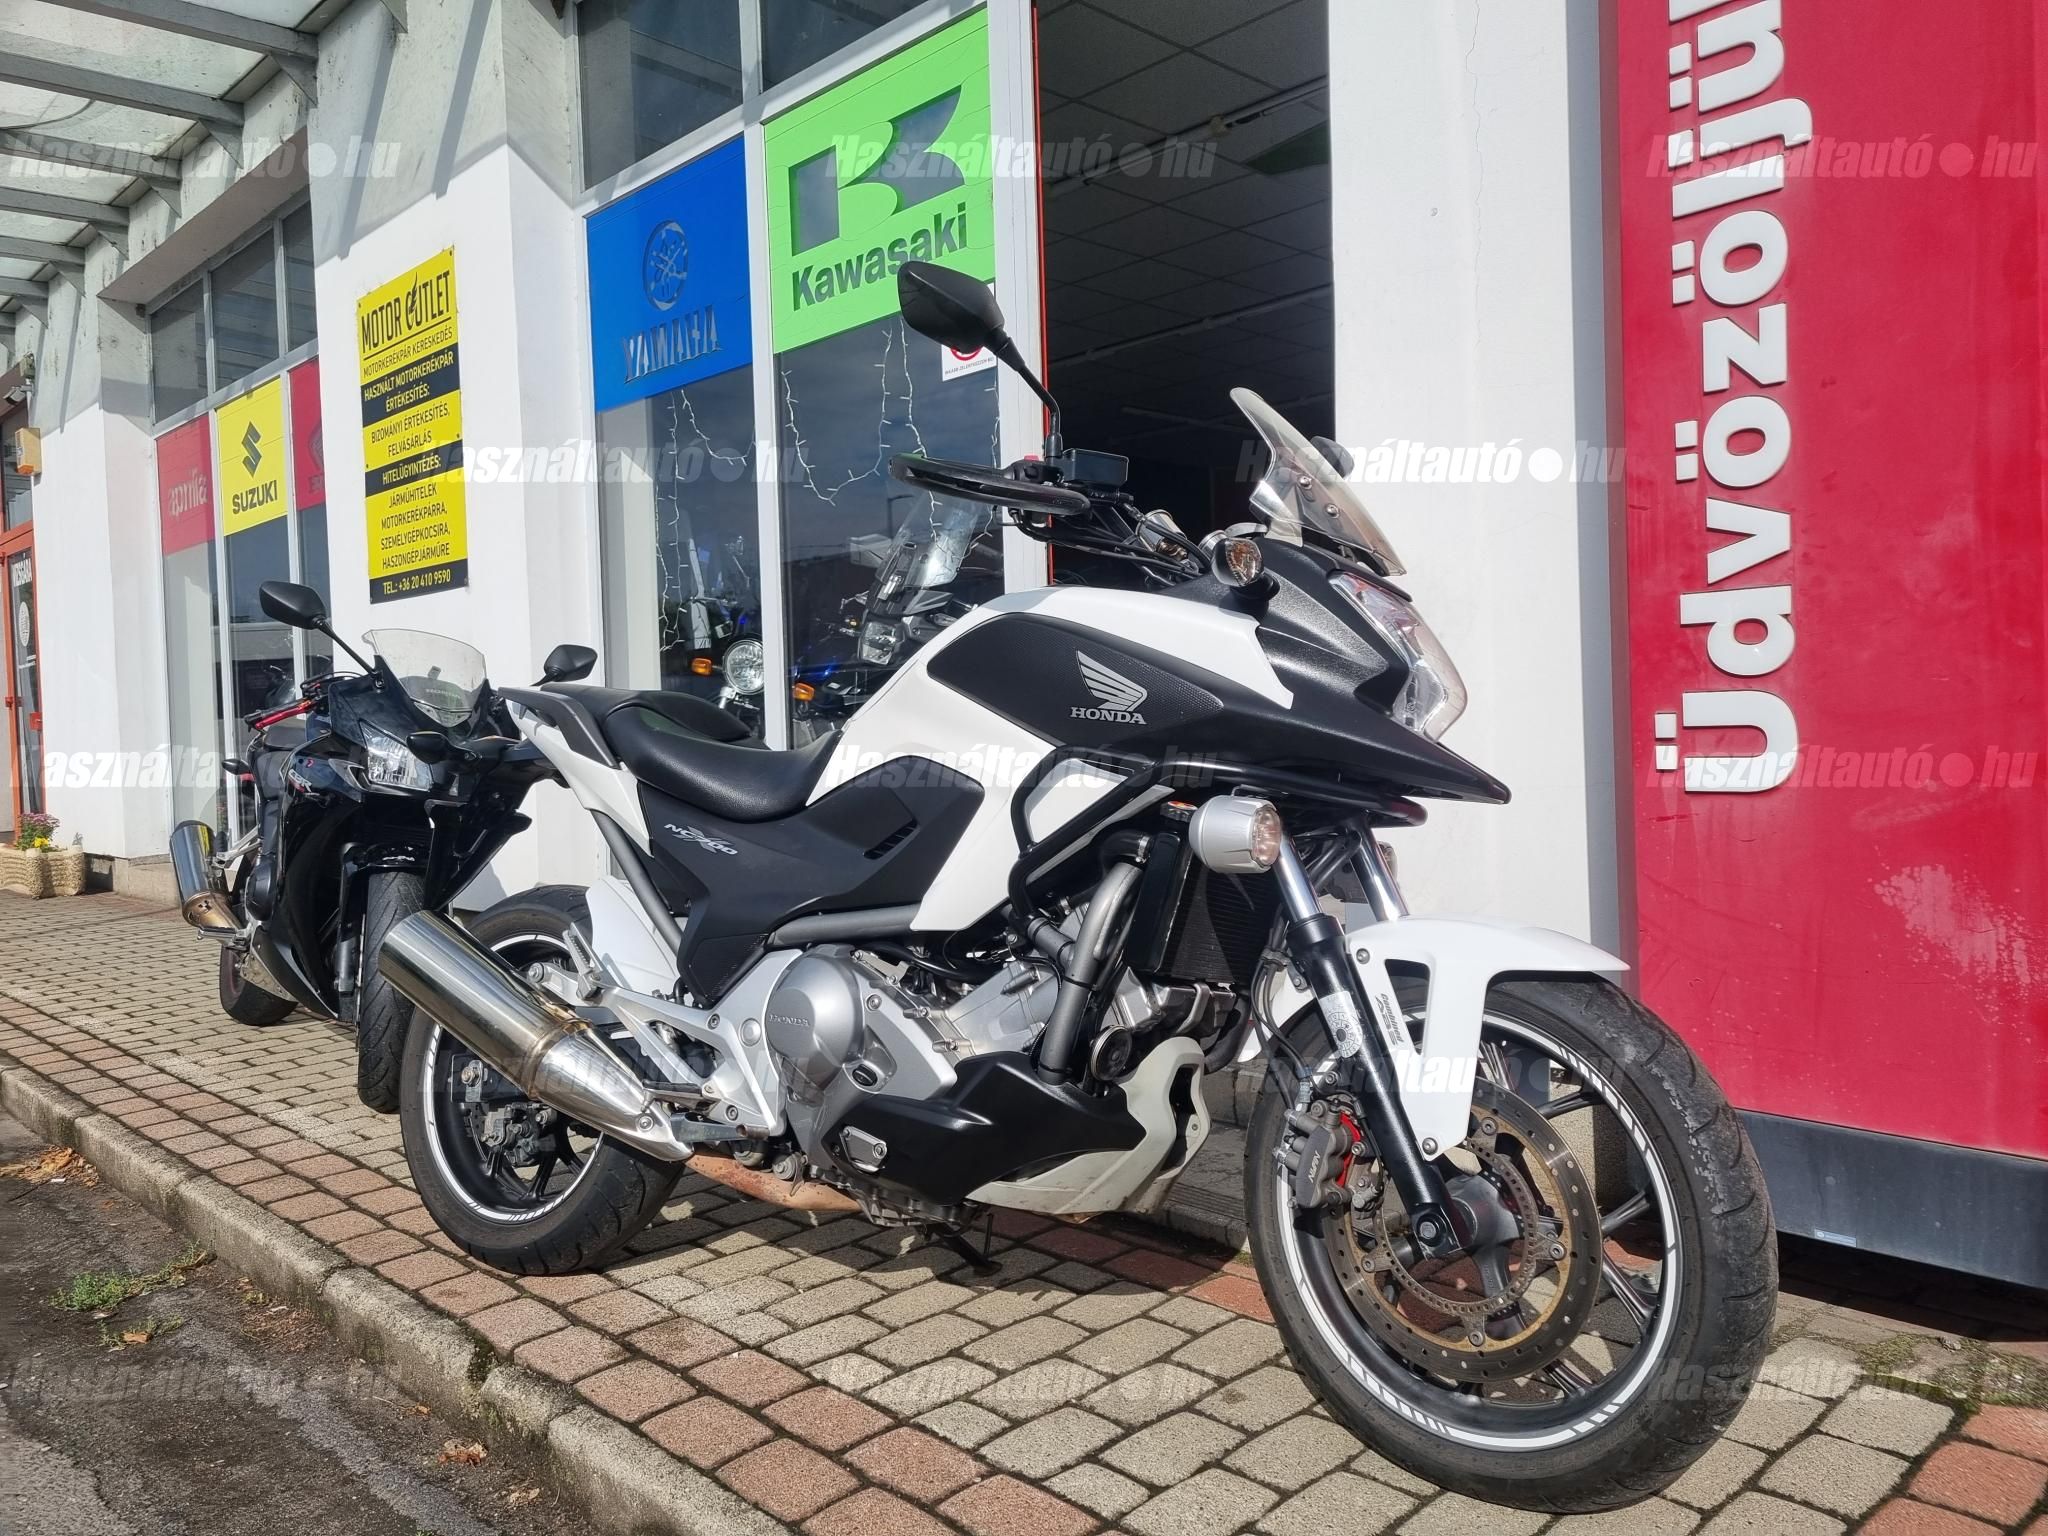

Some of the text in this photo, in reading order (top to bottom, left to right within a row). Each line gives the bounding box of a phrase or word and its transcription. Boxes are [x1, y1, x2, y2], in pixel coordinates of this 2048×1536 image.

[792, 202, 968, 311] Kawasaki
[362, 270, 450, 353] MOTOR OUTLET
[363, 326, 453, 378] MOTORKERÉKPÁR KERESKEDÉS
[622, 304, 721, 384] YAMAHA
[364, 349, 454, 402] HASZNÁLT MOTORKERÉKPÁR
[386, 382, 430, 412] ÉRTÉKESÍTÉS:
[1655, 0, 1813, 793] Üdvözöljü
[371, 420, 403, 443] BIZOMÁNYI
[387, 430, 432, 457] FELVÁSÁRLÁS
[382, 453, 442, 485] HITELÜGYINTÉZÉS:
[232, 480, 278, 515] SUZUKI
[381, 502, 448, 531] MOTORKERÉKPÁRRA,
[380, 523, 451, 551] SZEMÉLYGÉPKOCSIRA,
[382, 569, 451, 596] TEL.: +36 20 410 9590
[1070, 706, 1148, 725] HONDA
[769, 1014, 811, 1027] HONDA
[1380, 992, 1405, 1043] Combined
